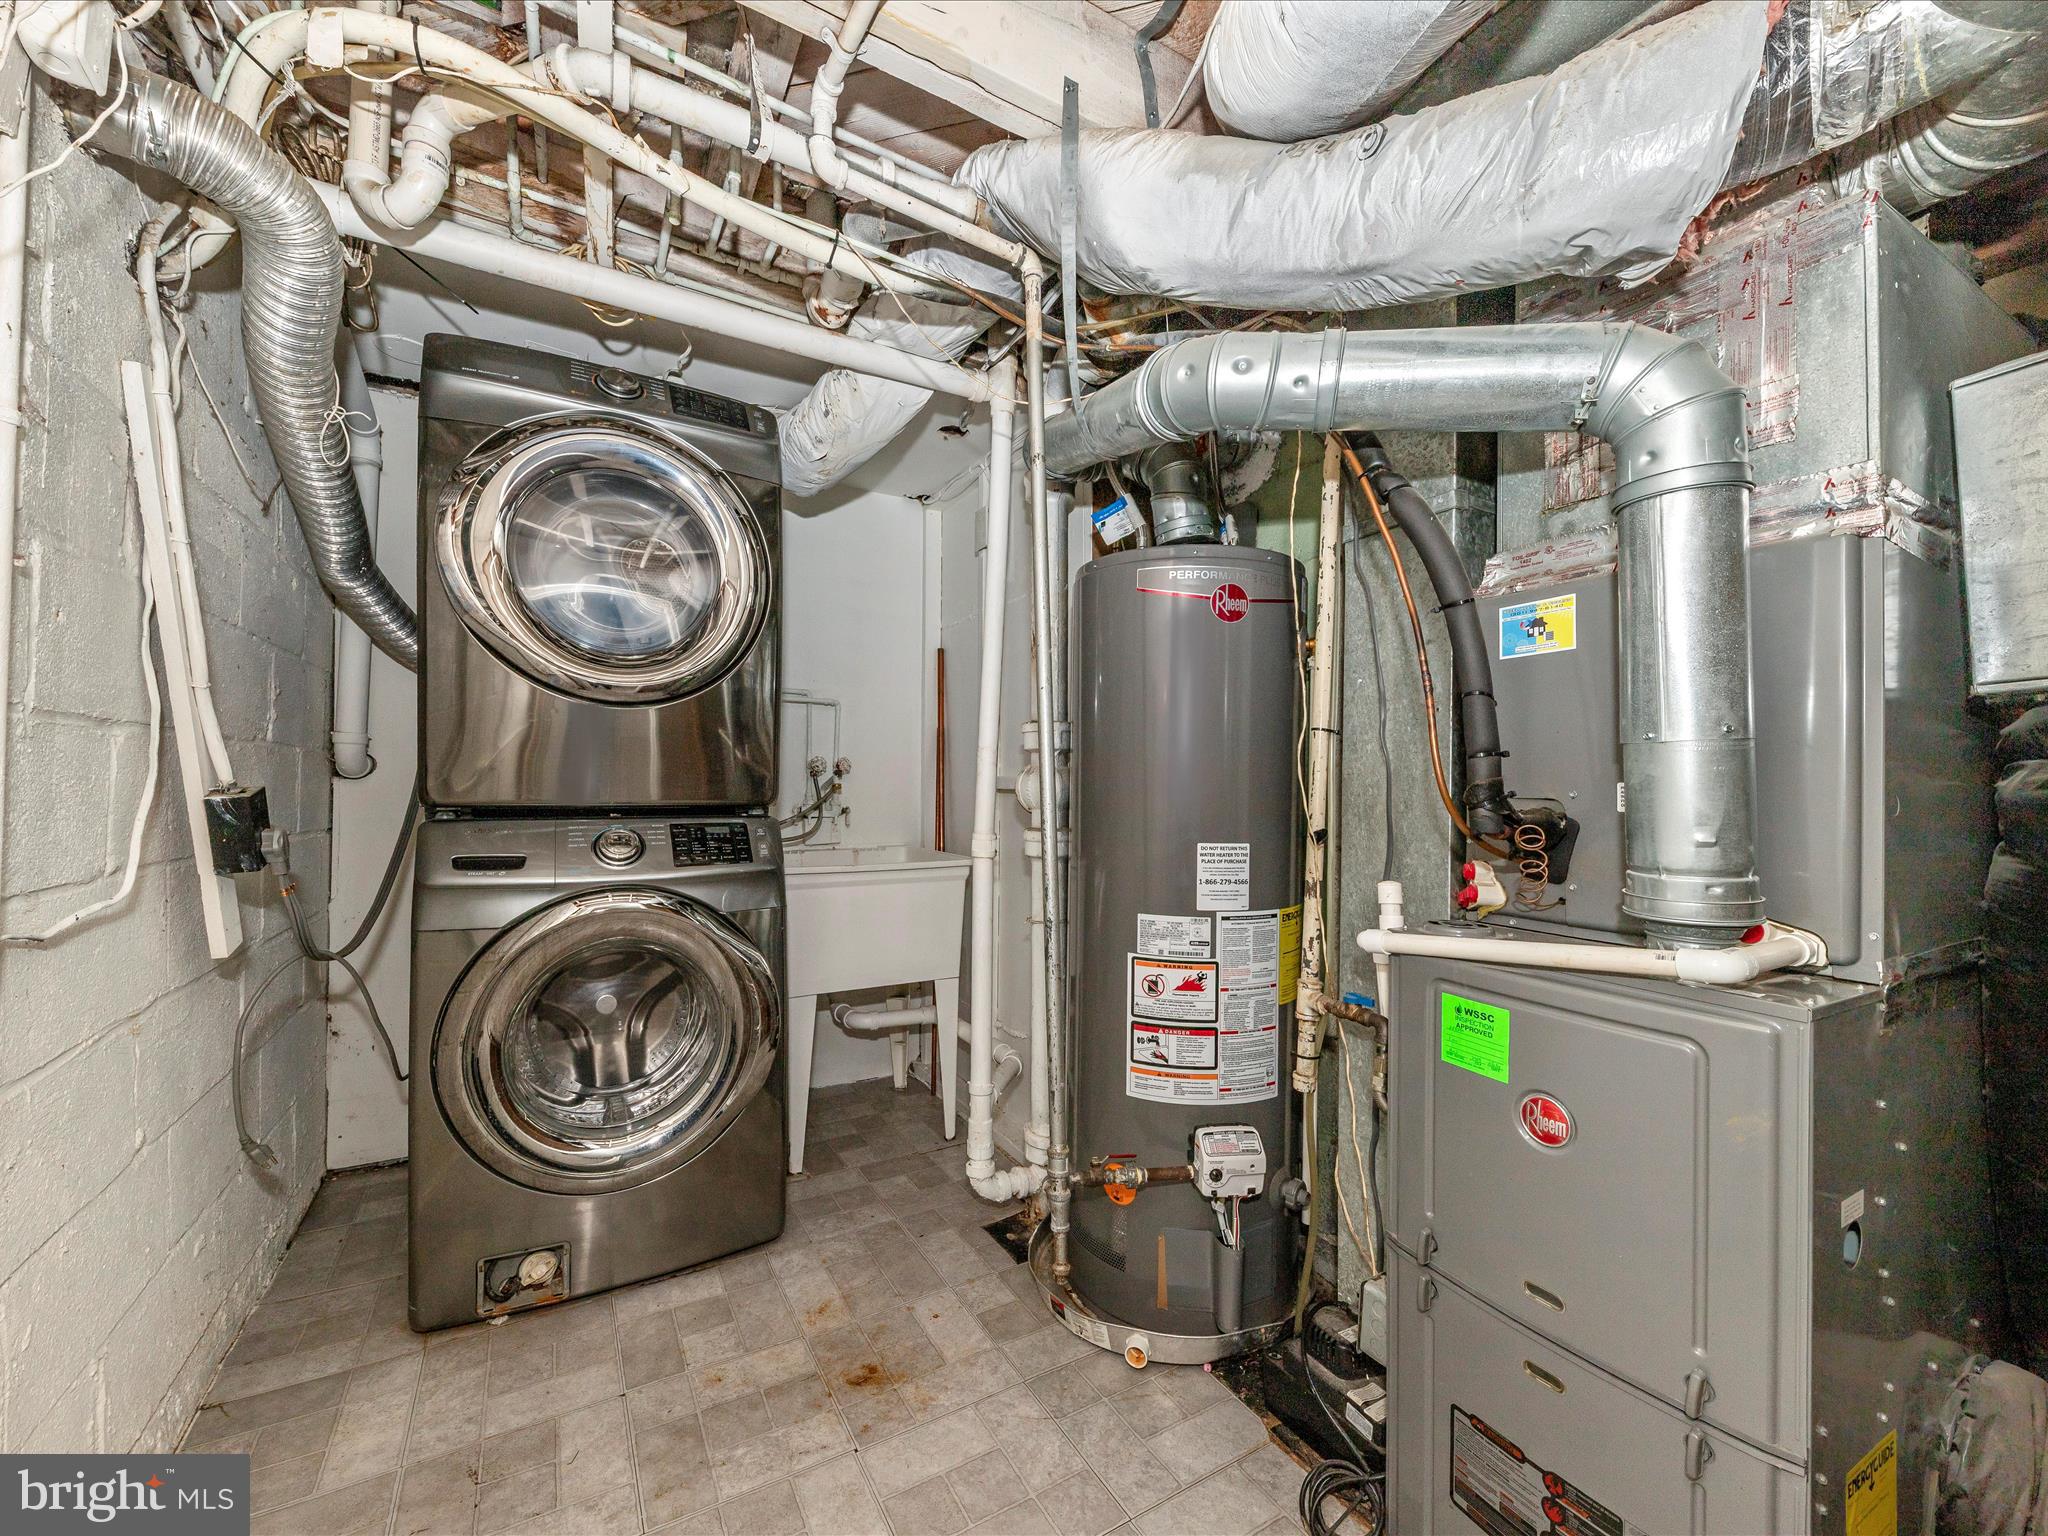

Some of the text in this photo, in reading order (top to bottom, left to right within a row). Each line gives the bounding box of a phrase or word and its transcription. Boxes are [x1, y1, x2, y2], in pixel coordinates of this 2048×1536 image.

[1215, 584, 1247, 616] Rheem
[1455, 1015, 1495, 1032] INSPECTION
[1464, 1006, 1495, 1023] WSSC
[1456, 1022, 1493, 1039] APPROVED
[1526, 1099, 1567, 1138] Rheem
[1847, 1440, 1895, 1500] ENERGYGUIDE
